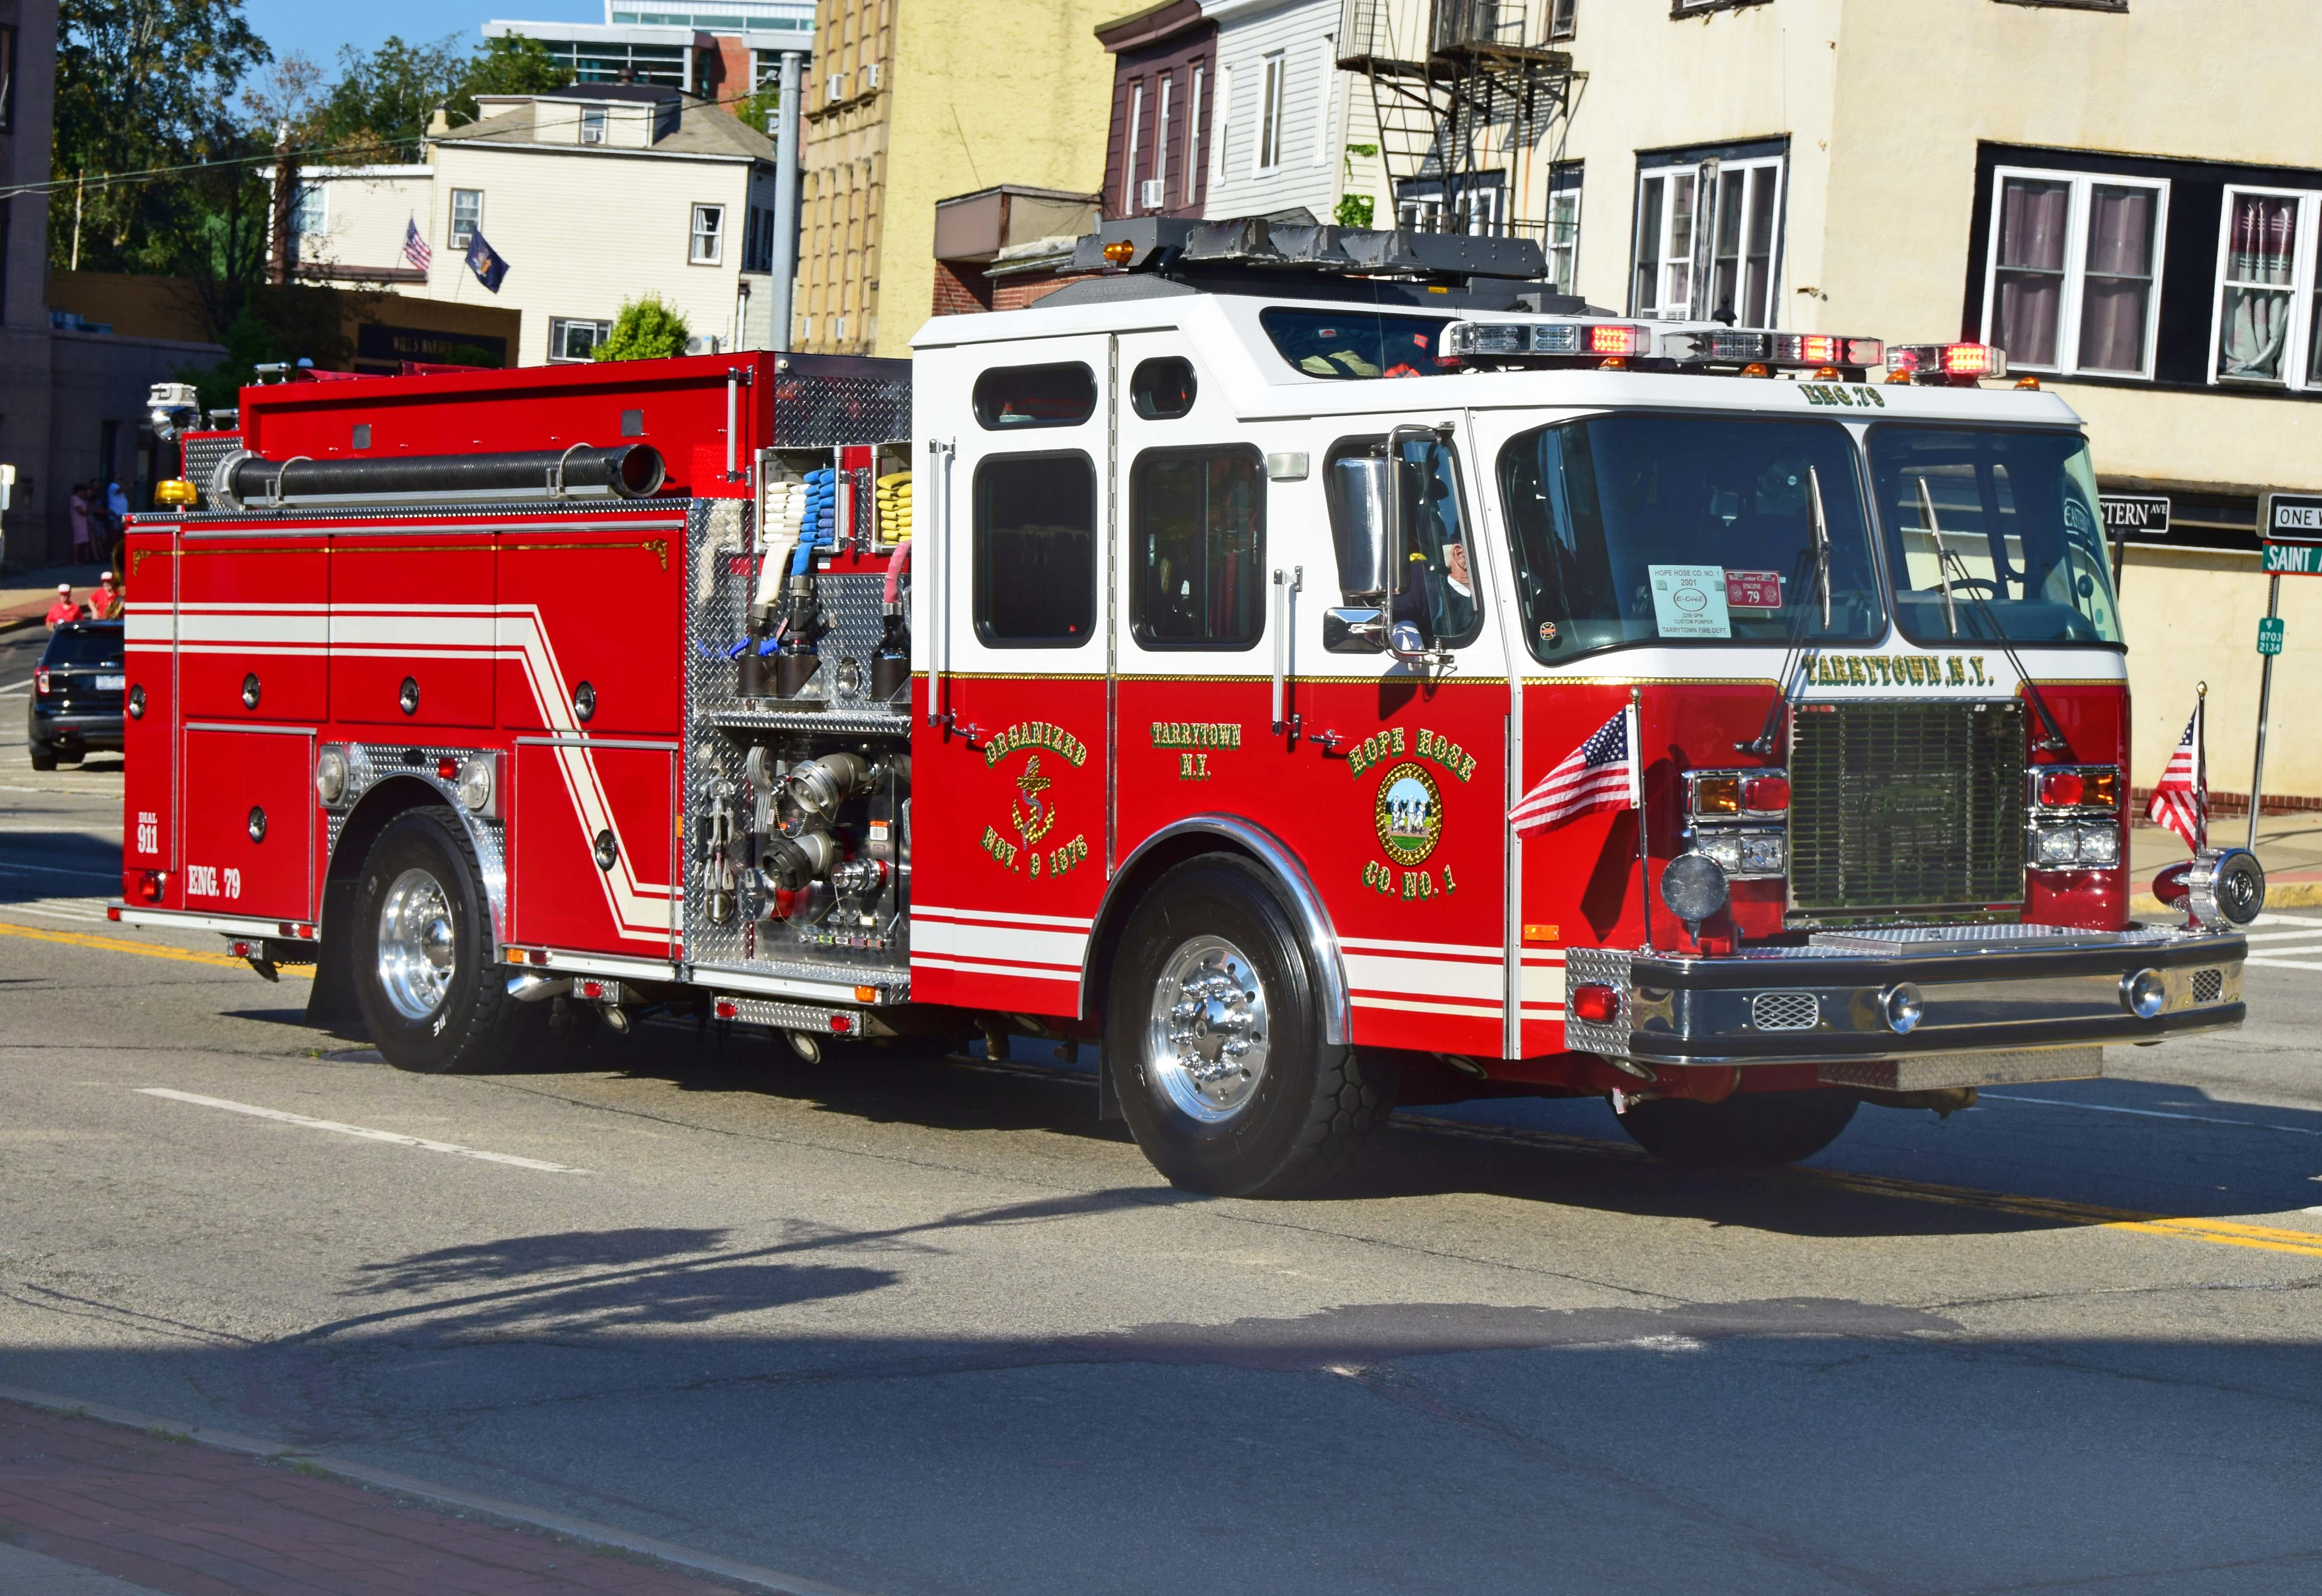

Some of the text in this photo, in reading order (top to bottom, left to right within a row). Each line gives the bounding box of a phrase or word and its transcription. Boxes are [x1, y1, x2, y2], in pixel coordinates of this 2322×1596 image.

[2150, 504, 2166, 514] AVE
[2280, 509, 2313, 525] ONE
[2267, 545, 2312, 572] SAINT
[1747, 591, 1760, 603] 79
[2260, 632, 2282, 642] 8703
[2266, 620, 2272, 629] 9
[2259, 641, 2281, 652] 2134
[985, 721, 1087, 768] ORGANIZED
[1152, 722, 1242, 750] TARRYTOWN
[1179, 754, 1211, 780] N.Y.
[1348, 727, 1476, 783] HOPE HOSE
[138, 812, 157, 824] DIAL
[137, 824, 158, 854] 911
[980, 825, 1088, 879] NOV. 9 1876
[188, 865, 241, 899] ENG. 79
[1362, 861, 1456, 901] CO. NO. 1
